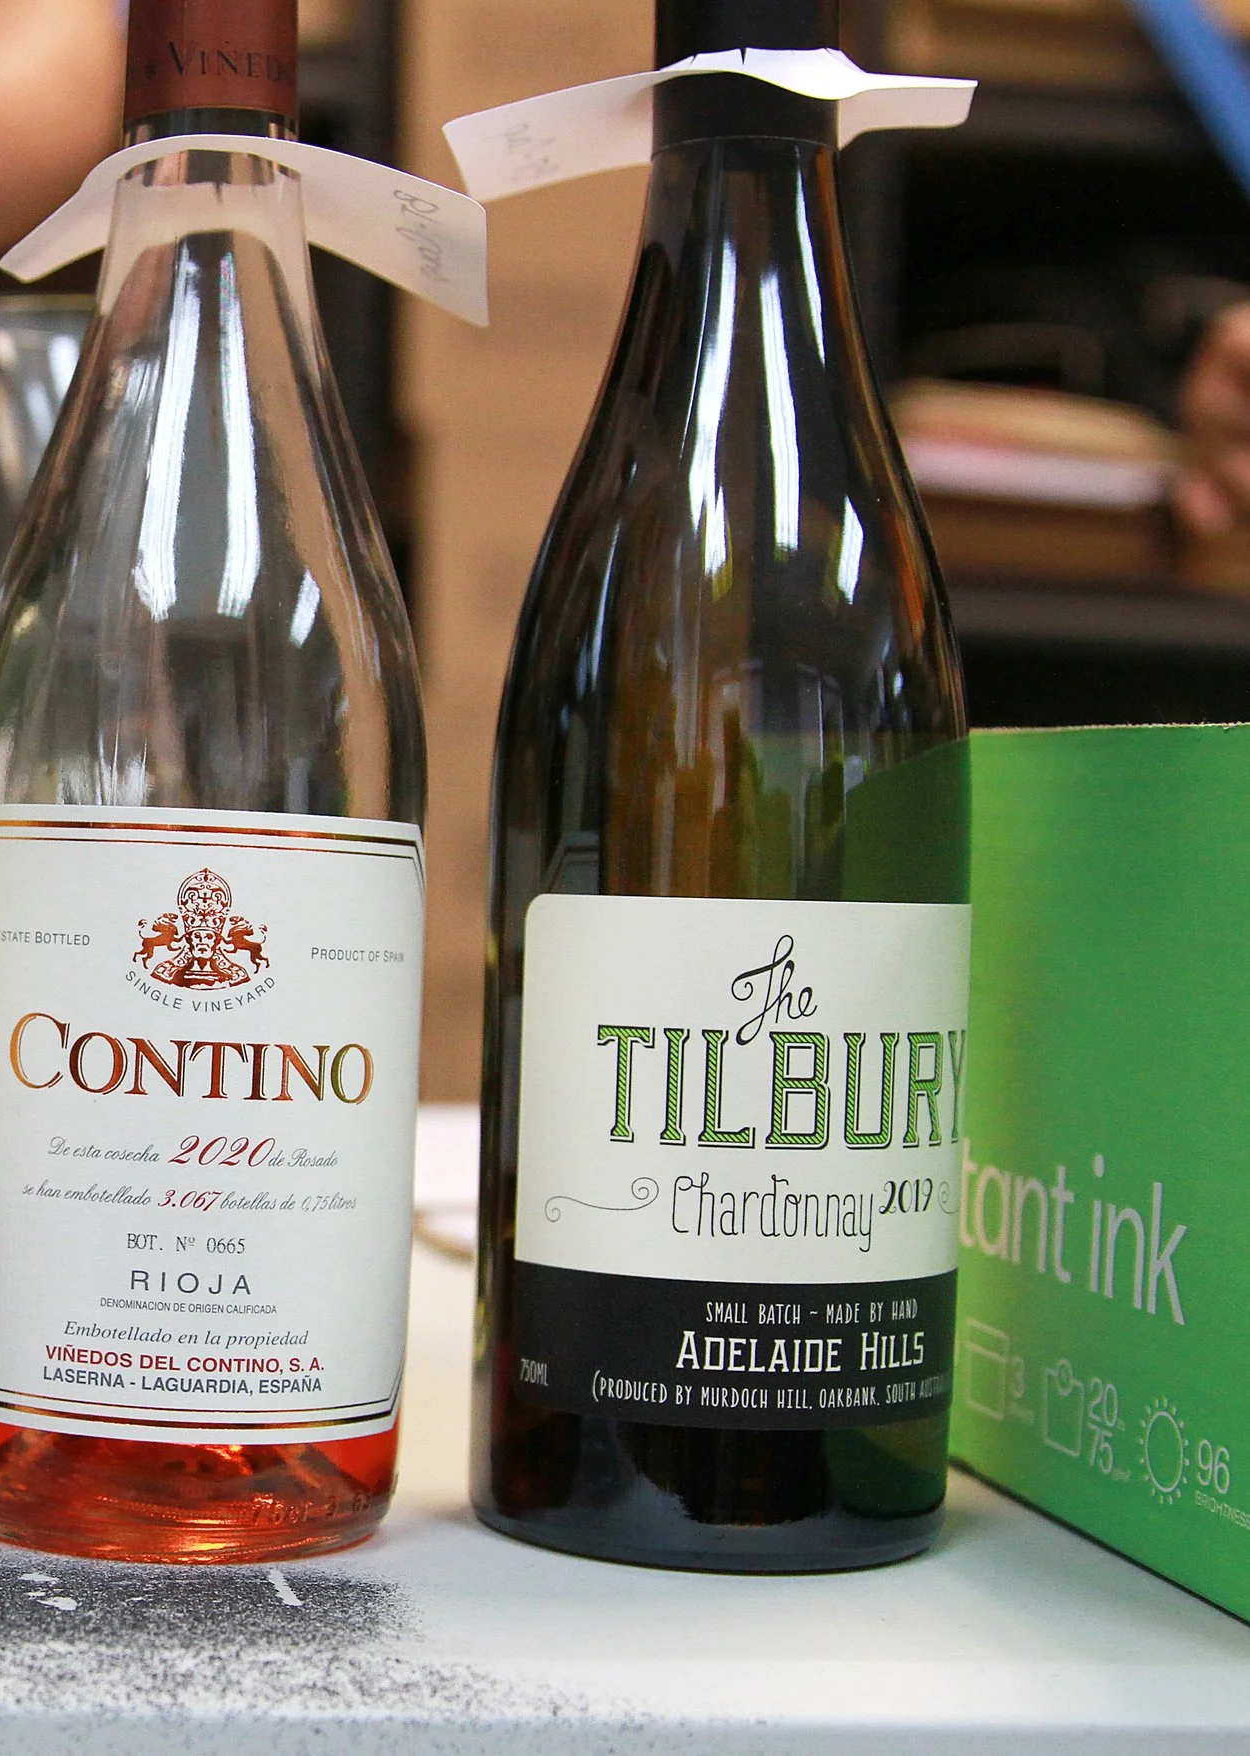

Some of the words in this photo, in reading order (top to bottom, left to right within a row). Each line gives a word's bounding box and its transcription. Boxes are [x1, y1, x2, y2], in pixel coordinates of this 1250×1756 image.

[34, 931, 90, 946] BOTTLED
[311, 947, 365, 961] PRODUCT
[368, 950, 380, 962] OF
[125, 970, 183, 1010] SINGLE
[192, 976, 275, 1012] VINEYARD
[731, 934, 818, 1046] The
[9, 1012, 375, 1105] CONTINO
[597, 1024, 967, 1150] TILBURY
[48, 1136, 70, 1156] De
[73, 1144, 101, 1158] esta
[104, 1144, 160, 1163] cosecha
[168, 1135, 276, 1168] 2020
[268, 1150, 285, 1167] de
[288, 1148, 338, 1167] Rosado
[22, 1183, 35, 1195] se
[36, 1179, 61, 1199] han
[64, 1183, 152, 1206] embotellado
[157, 1189, 224, 1212] 3.067
[220, 1191, 276, 1210] botellas
[279, 1194, 296, 1210] de
[672, 1172, 875, 1252] Chardonnay
[879, 1178, 934, 1215] 2019
[127, 1233, 163, 1251] BOT.
[206, 1237, 246, 1254] 0665
[1089, 1154, 1187, 1326] ink
[130, 1270, 251, 1295] RIOJA
[100, 1297, 170, 1313] DENOMINACION
[172, 1301, 186, 1313] DE
[188, 1303, 224, 1314] ORIGEN
[226, 1304, 277, 1315] CALIFICADA
[706, 1301, 748, 1324] SMALL
[758, 1303, 801, 1325] BATCH
[825, 1302, 860, 1324] MADE
[870, 1300, 883, 1322] BY
[891, 1298, 918, 1320] HAND
[63, 1321, 172, 1344] Embotellado
[178, 1332, 200, 1345] en
[204, 1330, 221, 1346] la
[225, 1330, 309, 1349] propiedad
[675, 1330, 842, 1372] ADELAIDE
[860, 1331, 925, 1371] HILLS
[45, 1345, 133, 1368] VIÑEDOS
[139, 1354, 180, 1371] DEL
[186, 1356, 284, 1375] CONTINO,
[519, 1358, 549, 1387] 750ML
[43, 1366, 125, 1388] LASERNA
[141, 1375, 254, 1396] LAGUARDIA,
[258, 1374, 322, 1395] ESPAÑA
[675, 1384, 693, 1406] BY
[700, 1388, 768, 1409] MURDOCH
[885, 1382, 916, 1404] SOUTH
[1087, 1377, 1119, 1427] 20
[1086, 1422, 1114, 1474] 75
[1197, 1439, 1230, 1494] 96
